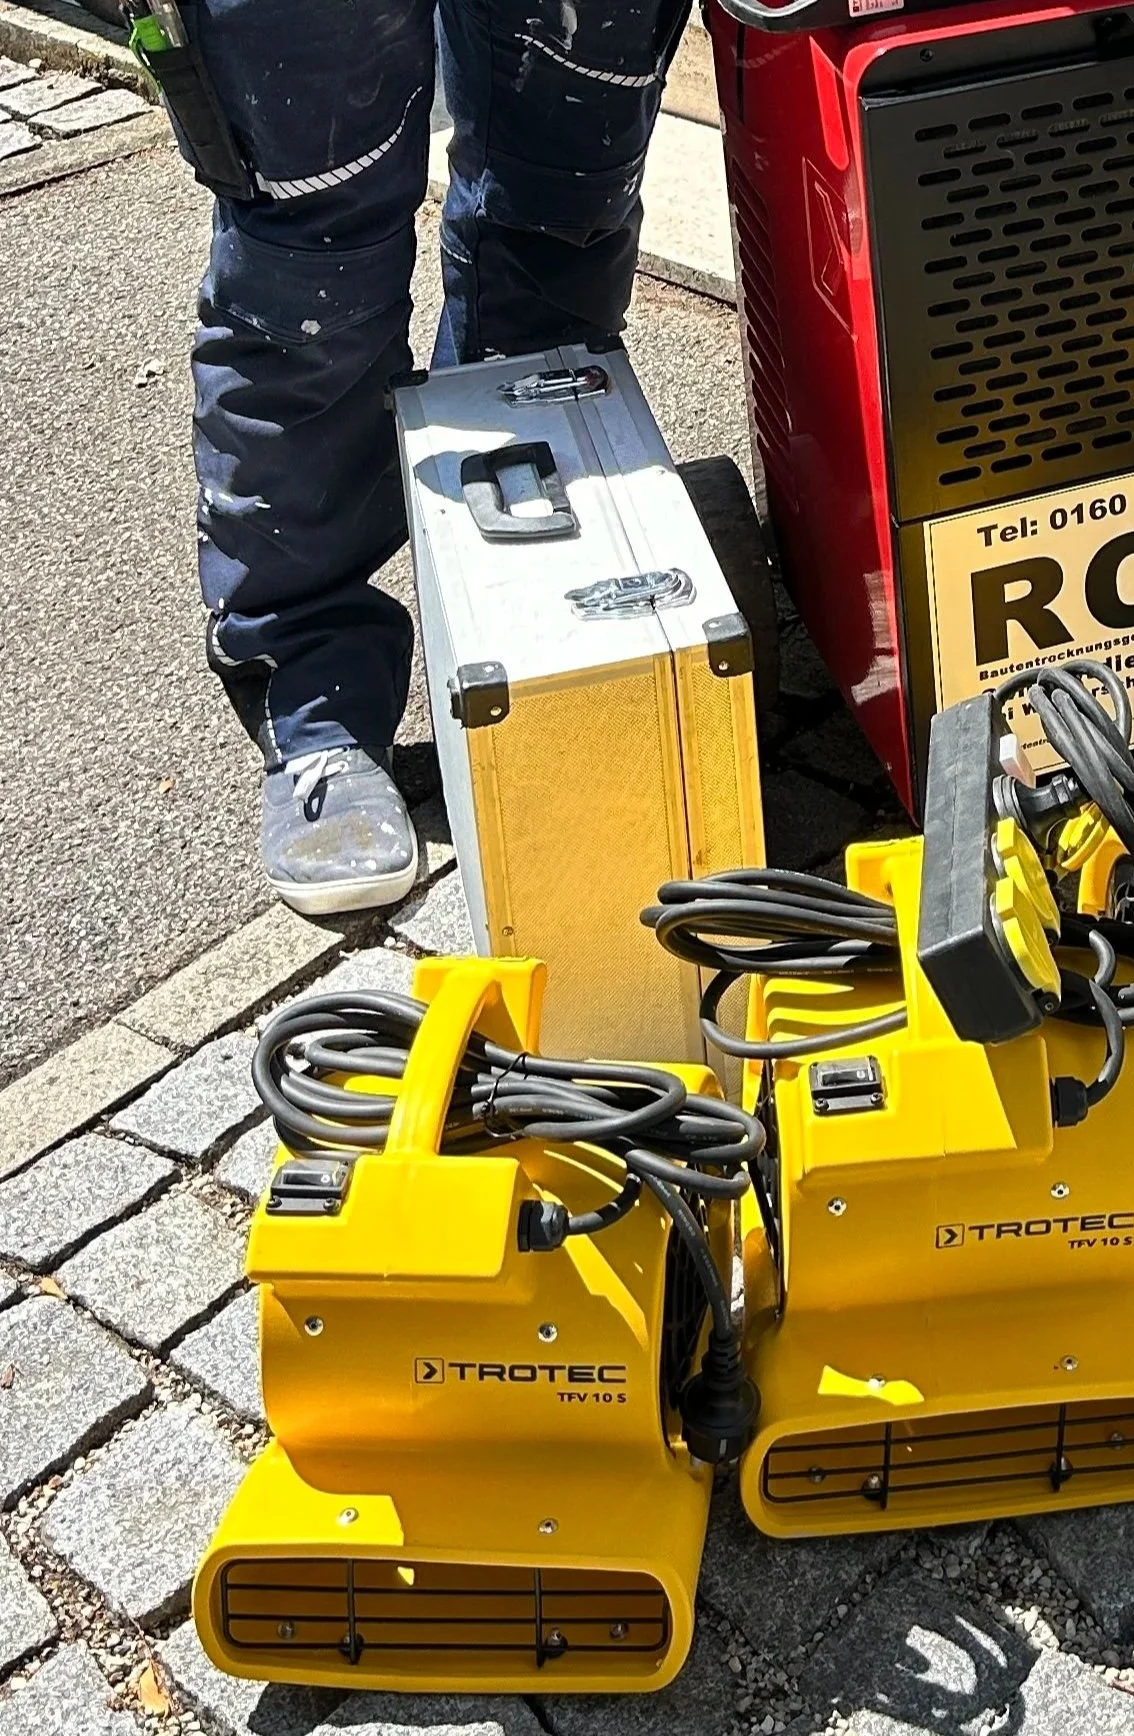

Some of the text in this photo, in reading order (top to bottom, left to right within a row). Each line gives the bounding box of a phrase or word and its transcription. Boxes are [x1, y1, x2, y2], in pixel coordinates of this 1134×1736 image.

[977, 516, 1038, 547] Tel:
[1050, 493, 1127, 530] 0160
[968, 1212, 1134, 1241] TROTEC
[1067, 1236, 1133, 1249] TFV 10 S
[448, 1362, 627, 1383] TROTEC
[557, 1391, 627, 1403] TFV 10 S
